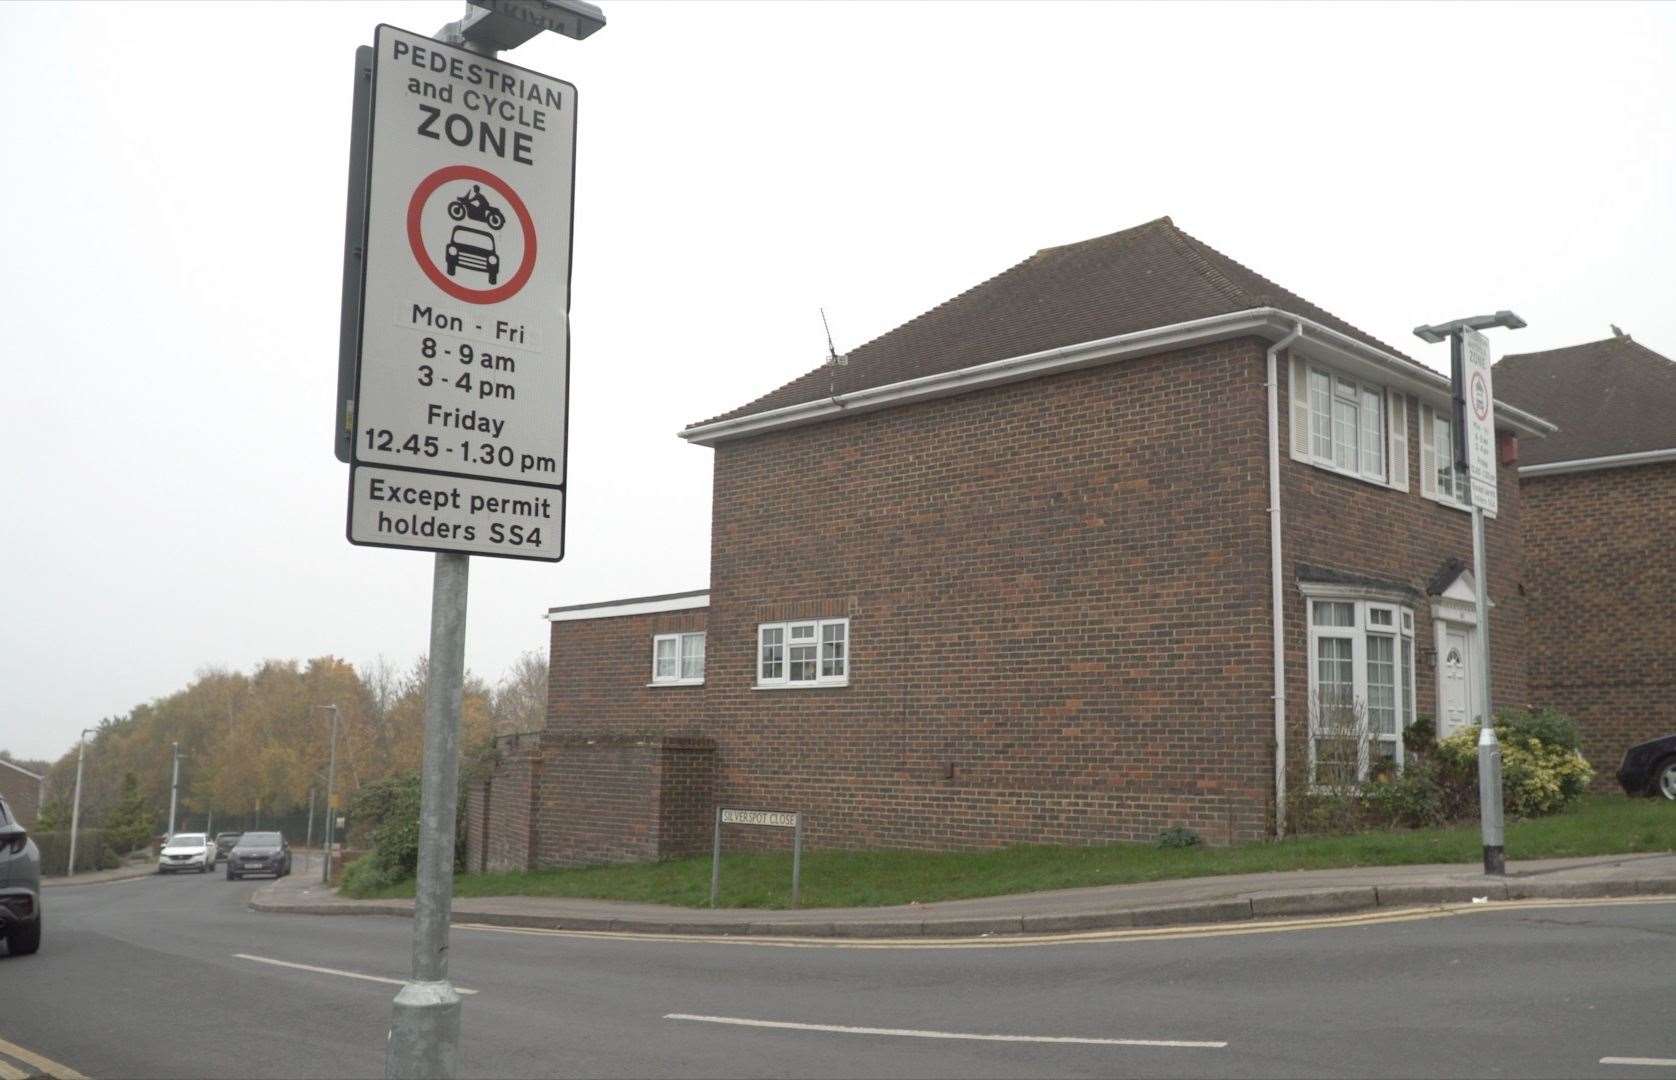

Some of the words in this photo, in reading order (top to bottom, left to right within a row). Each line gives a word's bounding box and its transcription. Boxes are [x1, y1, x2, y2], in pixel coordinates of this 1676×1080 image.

[393, 39, 562, 111] PEDESTRIAN
[407, 77, 453, 104] and
[463, 90, 546, 132] CYCLE
[417, 103, 534, 165] ZONE
[411, 304, 463, 332] Mon
[496, 320, 525, 344] Fri
[427, 403, 505, 438] Friday
[520, 454, 557, 473] pm
[369, 478, 461, 511] Except
[470, 495, 551, 519] permit
[378, 510, 476, 542] holders
[488, 522, 542, 548] SS4
[770, 814, 794, 825] CLOSE
